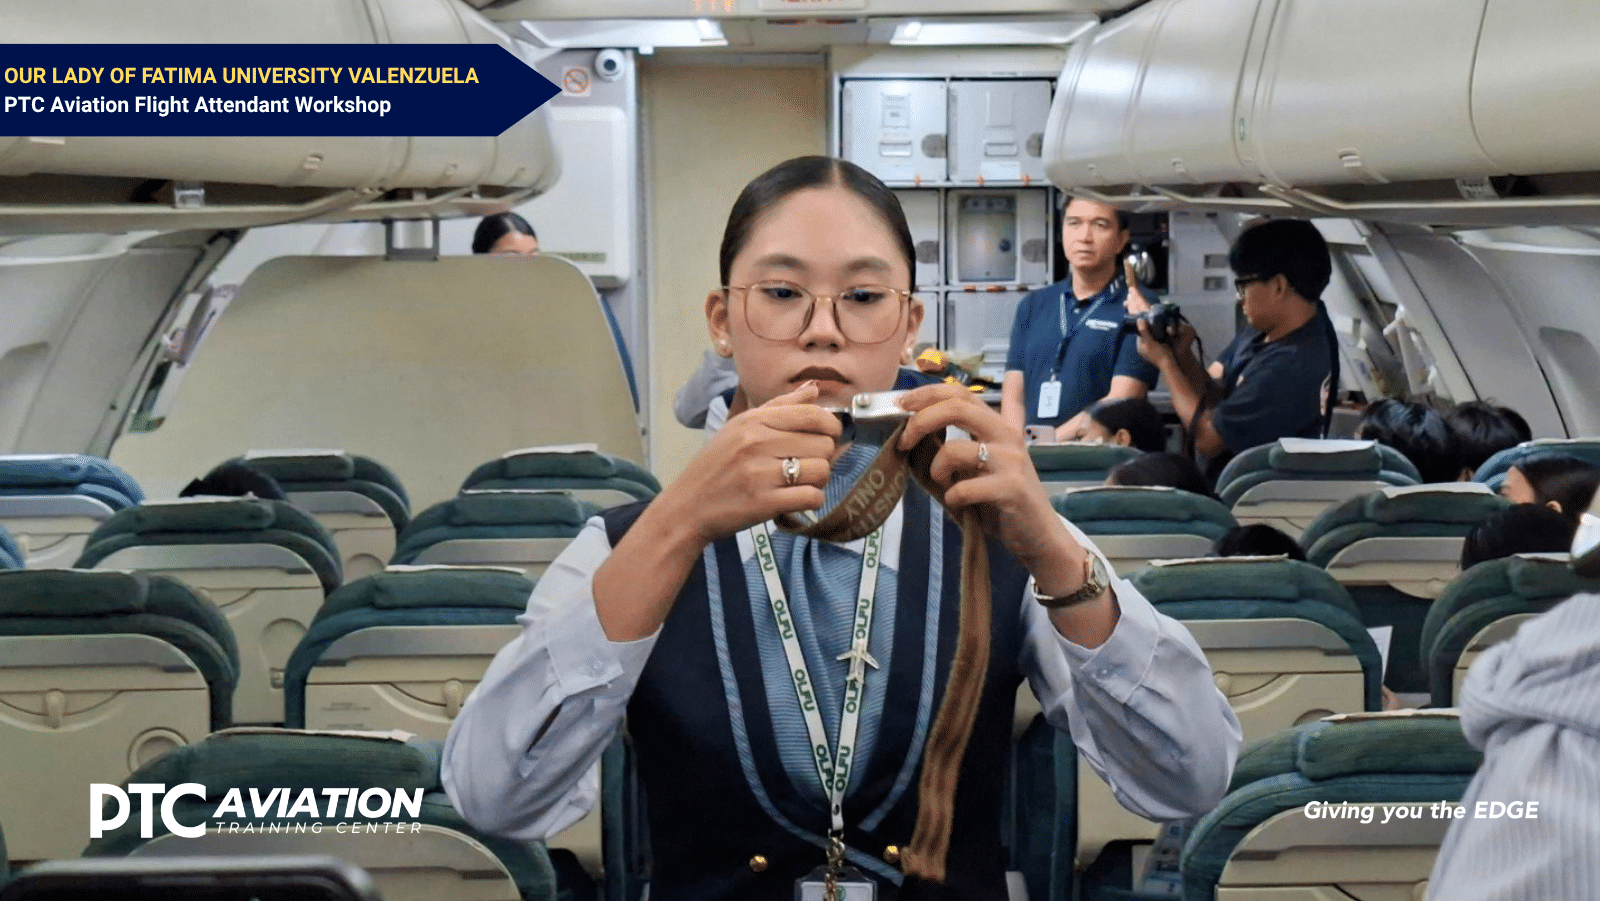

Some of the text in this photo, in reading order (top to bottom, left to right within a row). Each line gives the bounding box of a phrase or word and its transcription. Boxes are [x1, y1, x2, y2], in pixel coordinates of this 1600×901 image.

[844, 468, 885, 522] ONLY
[756, 534, 775, 571] OLFU
[773, 599, 794, 640] OLFU
[794, 668, 815, 712] OLFU
[834, 745, 851, 792] OLFU
[845, 679, 860, 714] OLF
[855, 598, 871, 640] OLFU
